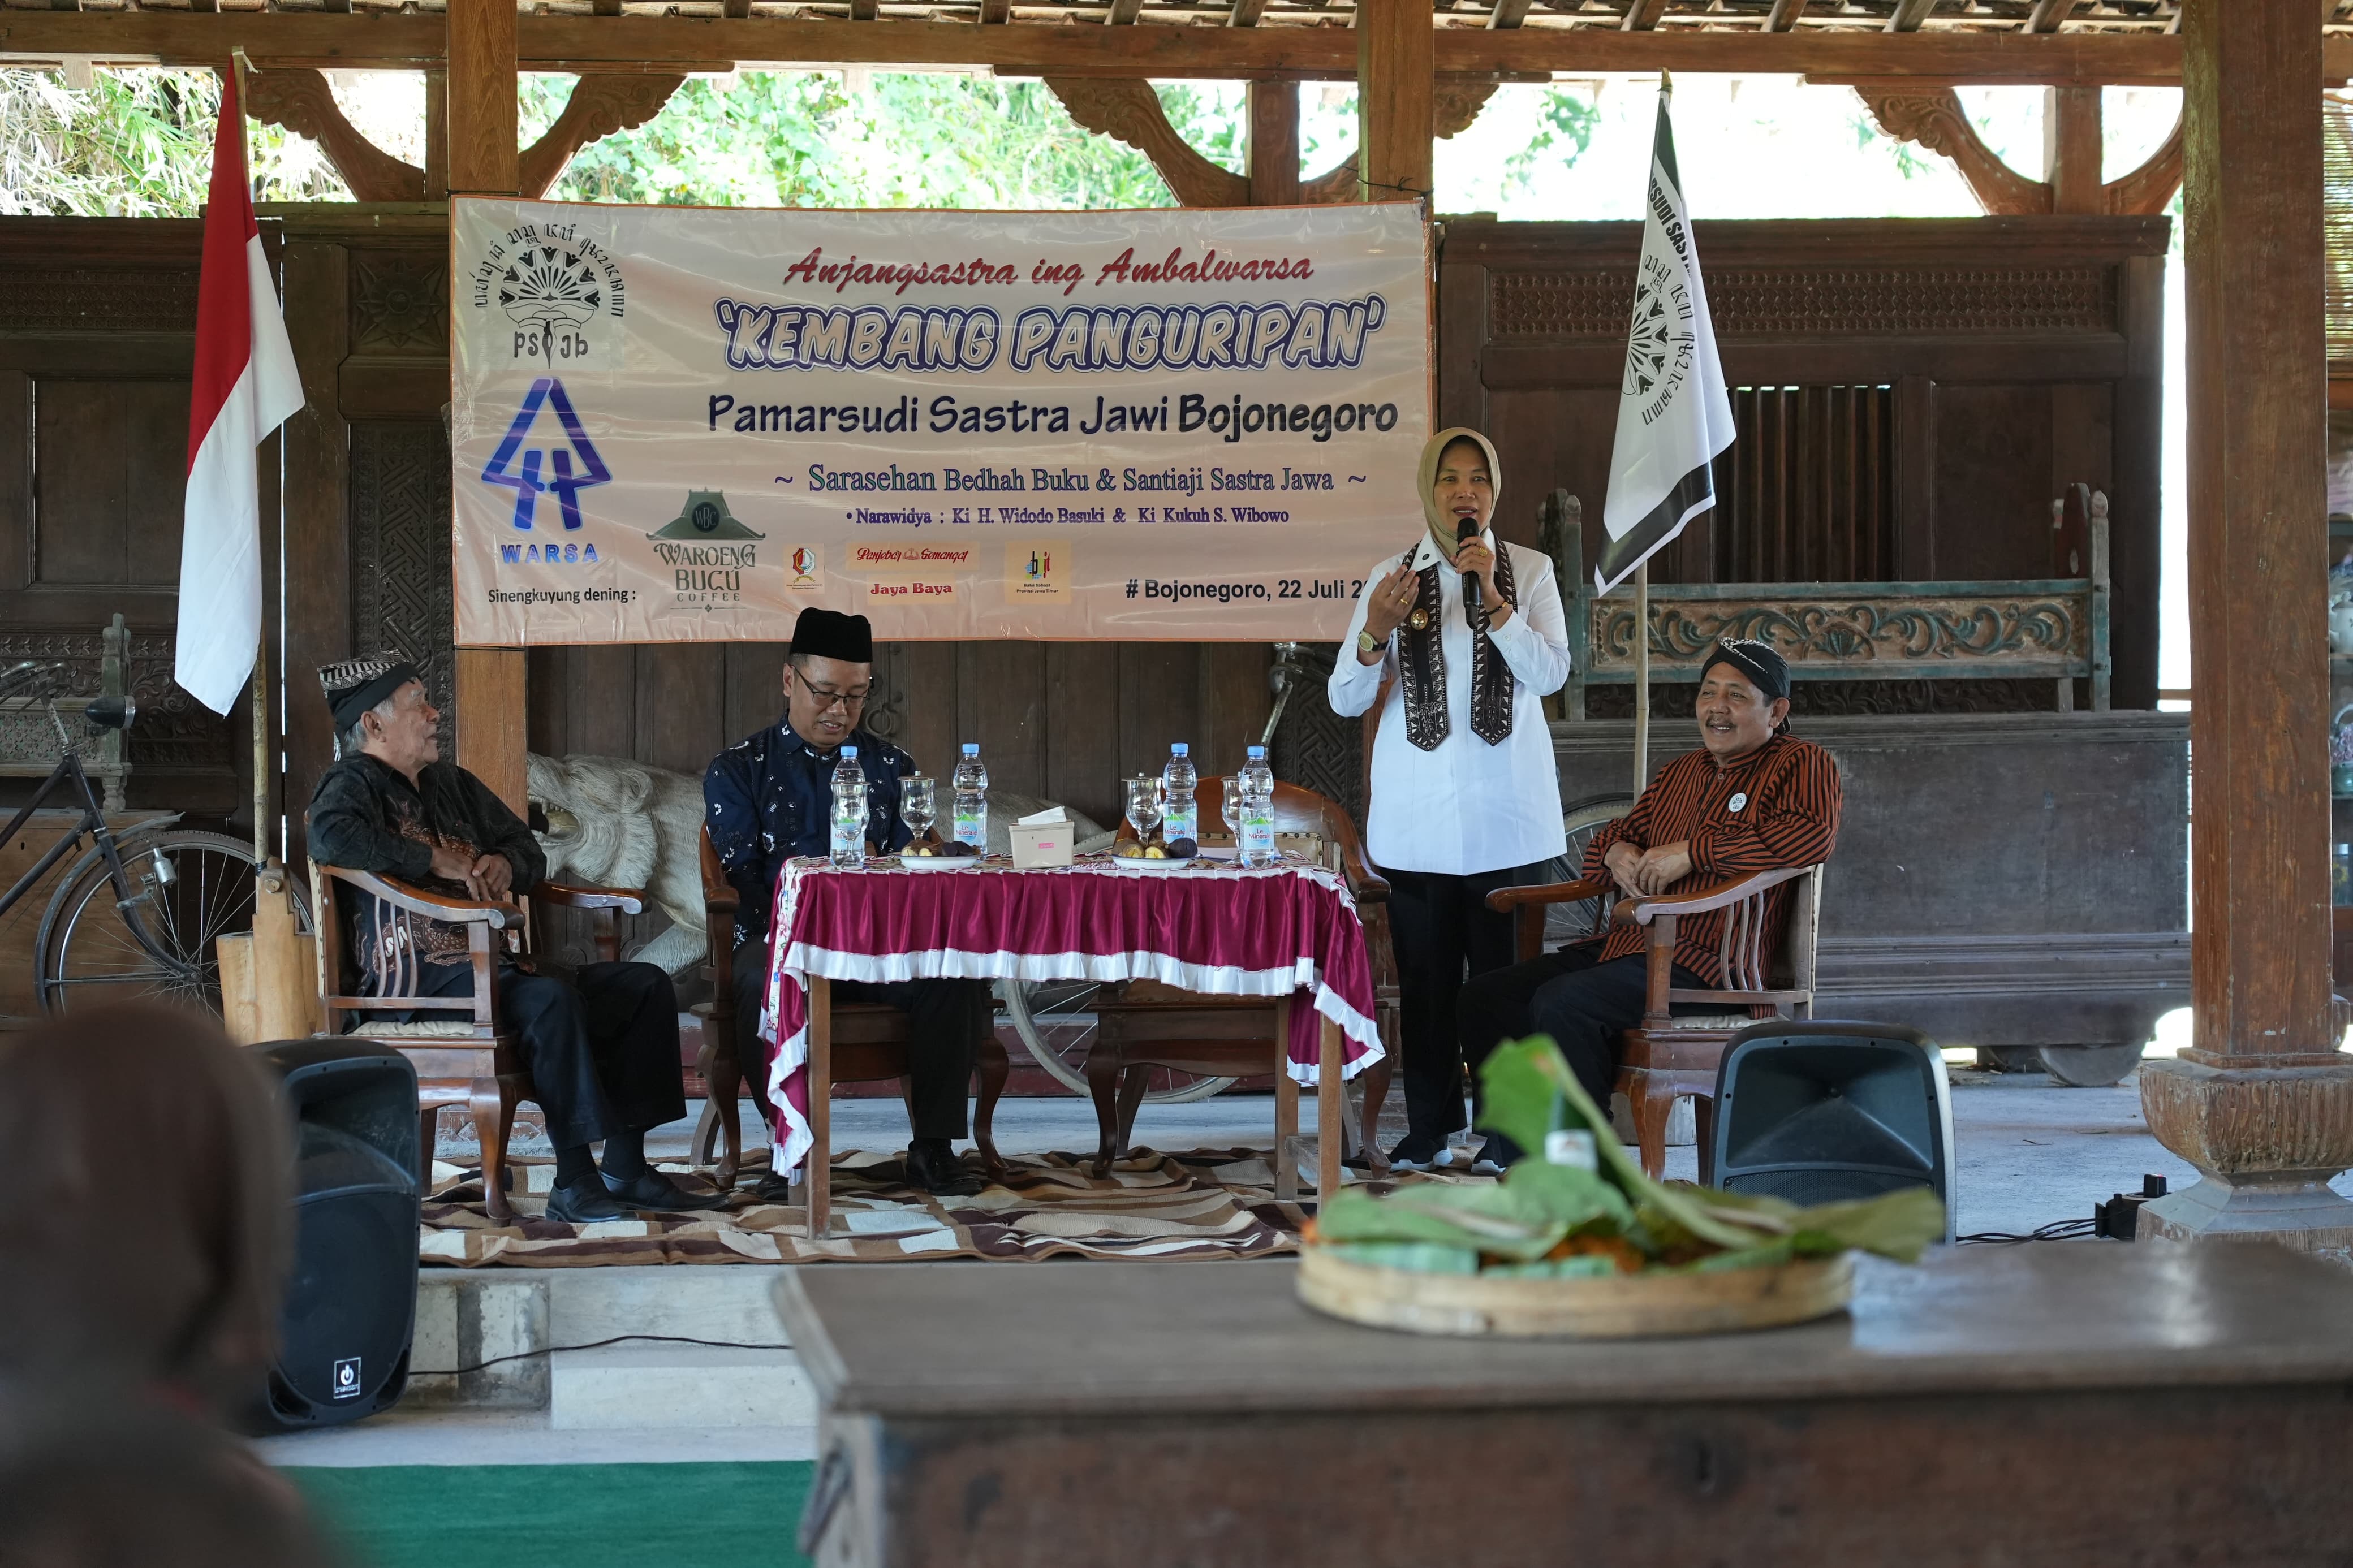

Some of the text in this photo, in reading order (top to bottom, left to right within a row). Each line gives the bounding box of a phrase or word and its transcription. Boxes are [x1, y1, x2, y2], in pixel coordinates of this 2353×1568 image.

[783, 247, 1315, 295] Anjangsastra ing Ambalwarsa
[709, 394, 1399, 443] Pamarsudi Sastra Jawi Bojonegoro
[809, 464, 937, 491] Sarasehan
[944, 469, 1025, 491] Bedhah
[1031, 468, 1089, 491] Buku
[1096, 468, 1116, 491] &
[1123, 467, 1204, 496] Santiaji
[1210, 467, 1275, 491] Sastra
[1281, 467, 1334, 491] Jawa
[953, 508, 970, 524] Ki
[977, 508, 995, 524] H.
[999, 508, 1054, 524] Widodo
[1057, 508, 1105, 523] Basuki
[1113, 508, 1126, 523] &
[1138, 507, 1156, 523] Ki
[1163, 507, 1210, 523] Kukuh
[1214, 507, 1227, 523] S.
[1231, 507, 1290, 522] Wibowo
[500, 543, 599, 564] WARSA
[653, 543, 757, 569] WAROENG
[488, 588, 580, 604] Sinengkuyung
[584, 588, 628, 603] dening
[677, 593, 740, 602] COFFEE
[870, 582, 953, 597] Jaya Baya
[1126, 578, 1139, 599] #
[1145, 579, 1271, 603] Bojonegoro,
[1278, 579, 1302, 598] 22
[1308, 579, 1344, 599] Juli
